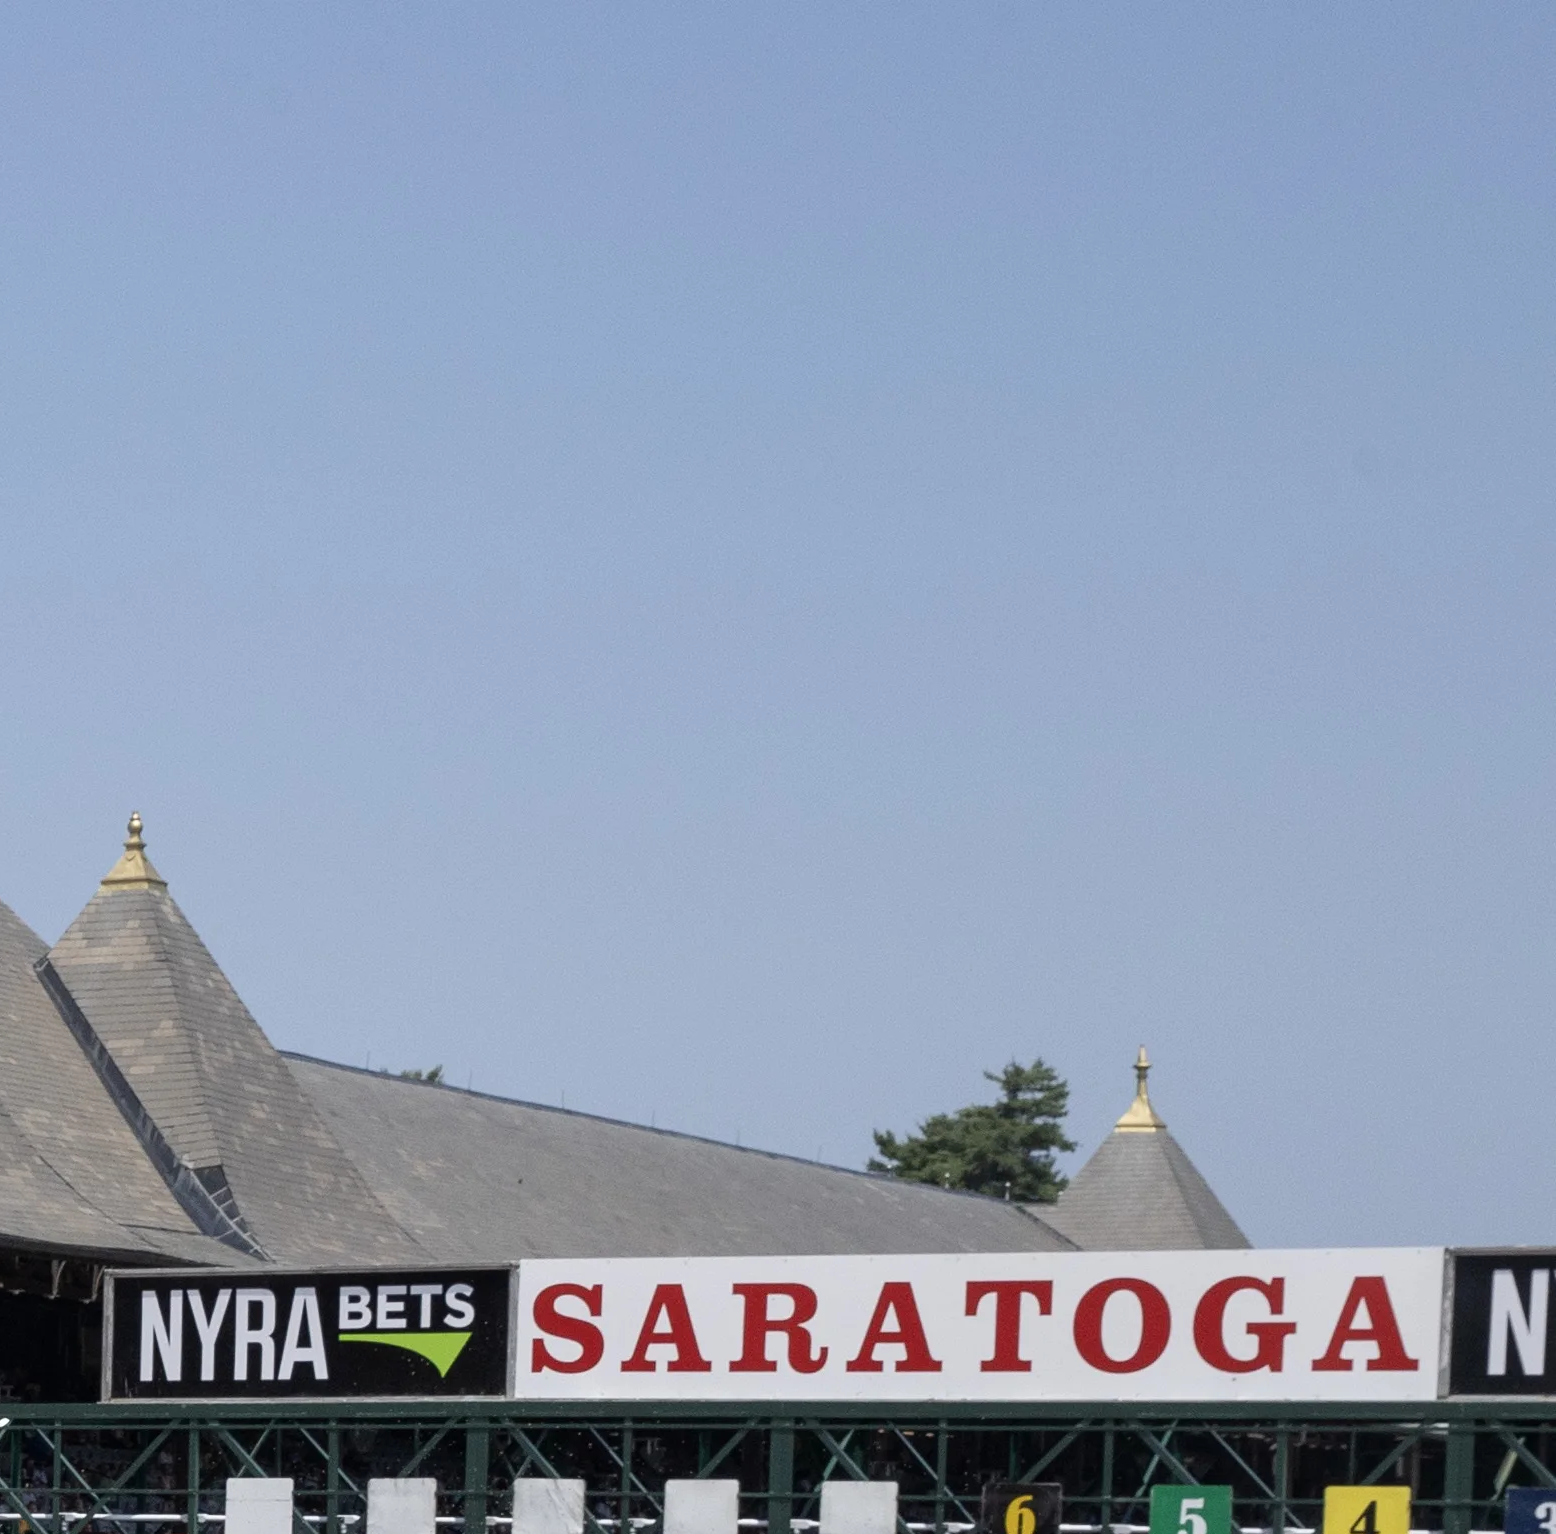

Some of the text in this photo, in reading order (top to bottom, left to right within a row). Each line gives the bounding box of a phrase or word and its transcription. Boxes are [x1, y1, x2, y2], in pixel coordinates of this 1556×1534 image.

[140, 1284, 475, 1382] NYRA BETS
[531, 1276, 1419, 1374] SARATOGA
[1486, 1268, 1556, 1376] N
